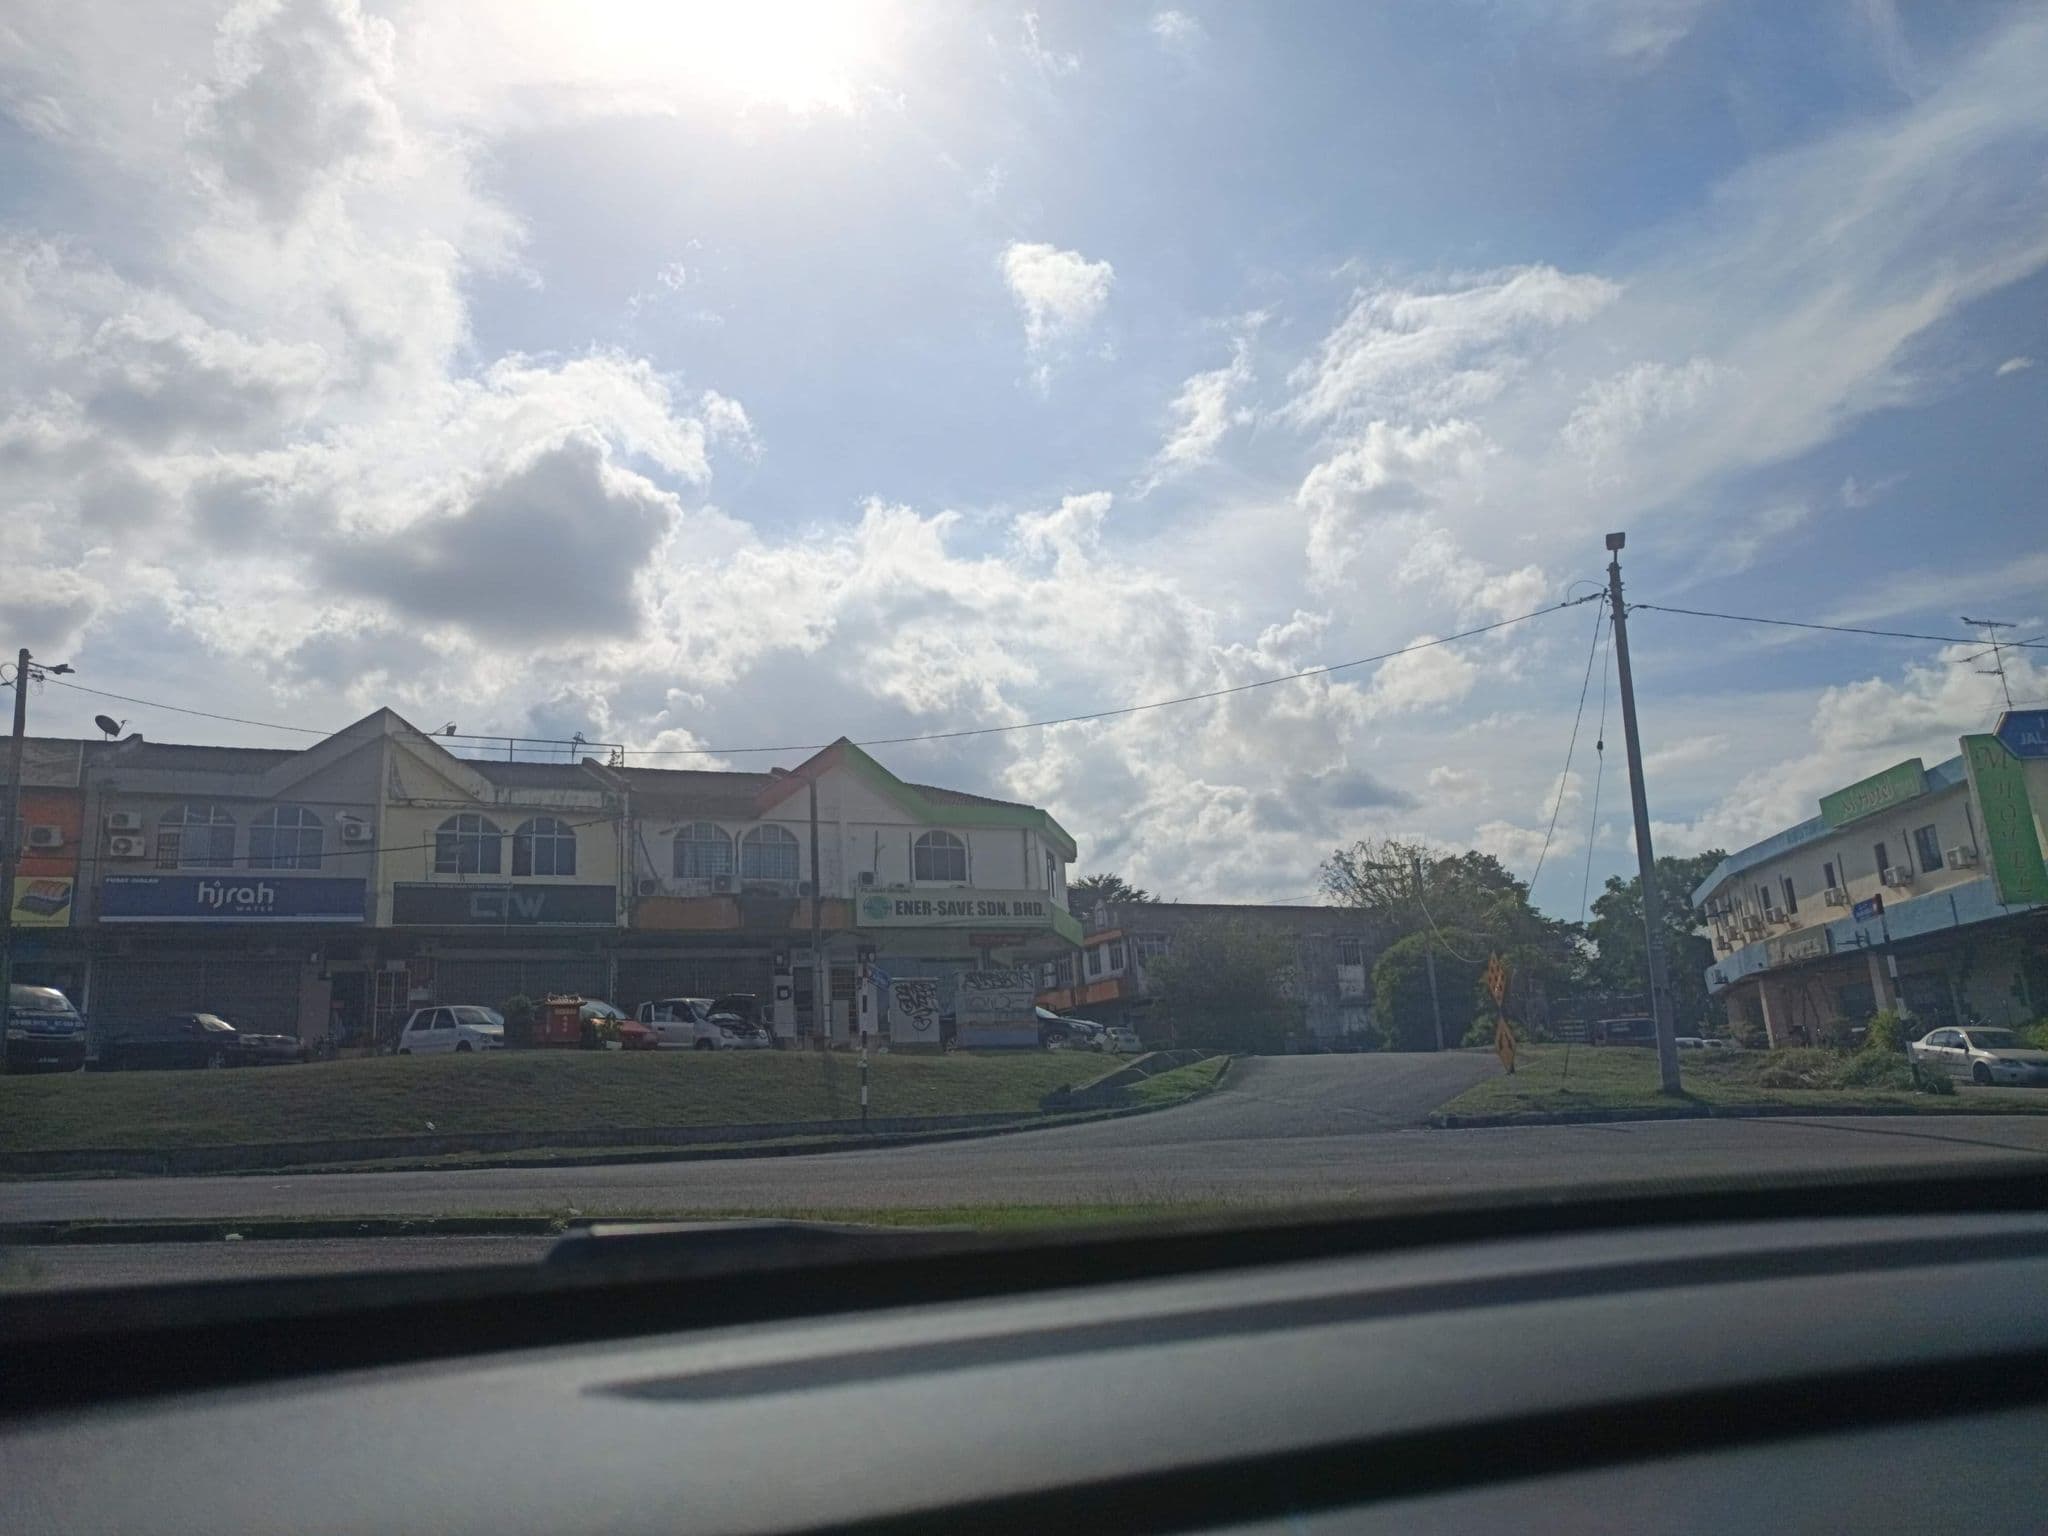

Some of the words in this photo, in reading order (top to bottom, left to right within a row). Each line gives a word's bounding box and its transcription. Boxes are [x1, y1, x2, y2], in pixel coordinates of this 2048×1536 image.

[895, 899, 974, 917] ENER-SAVE
[977, 900, 1010, 917] SDN.
[1013, 901, 1047, 917] BHD.
